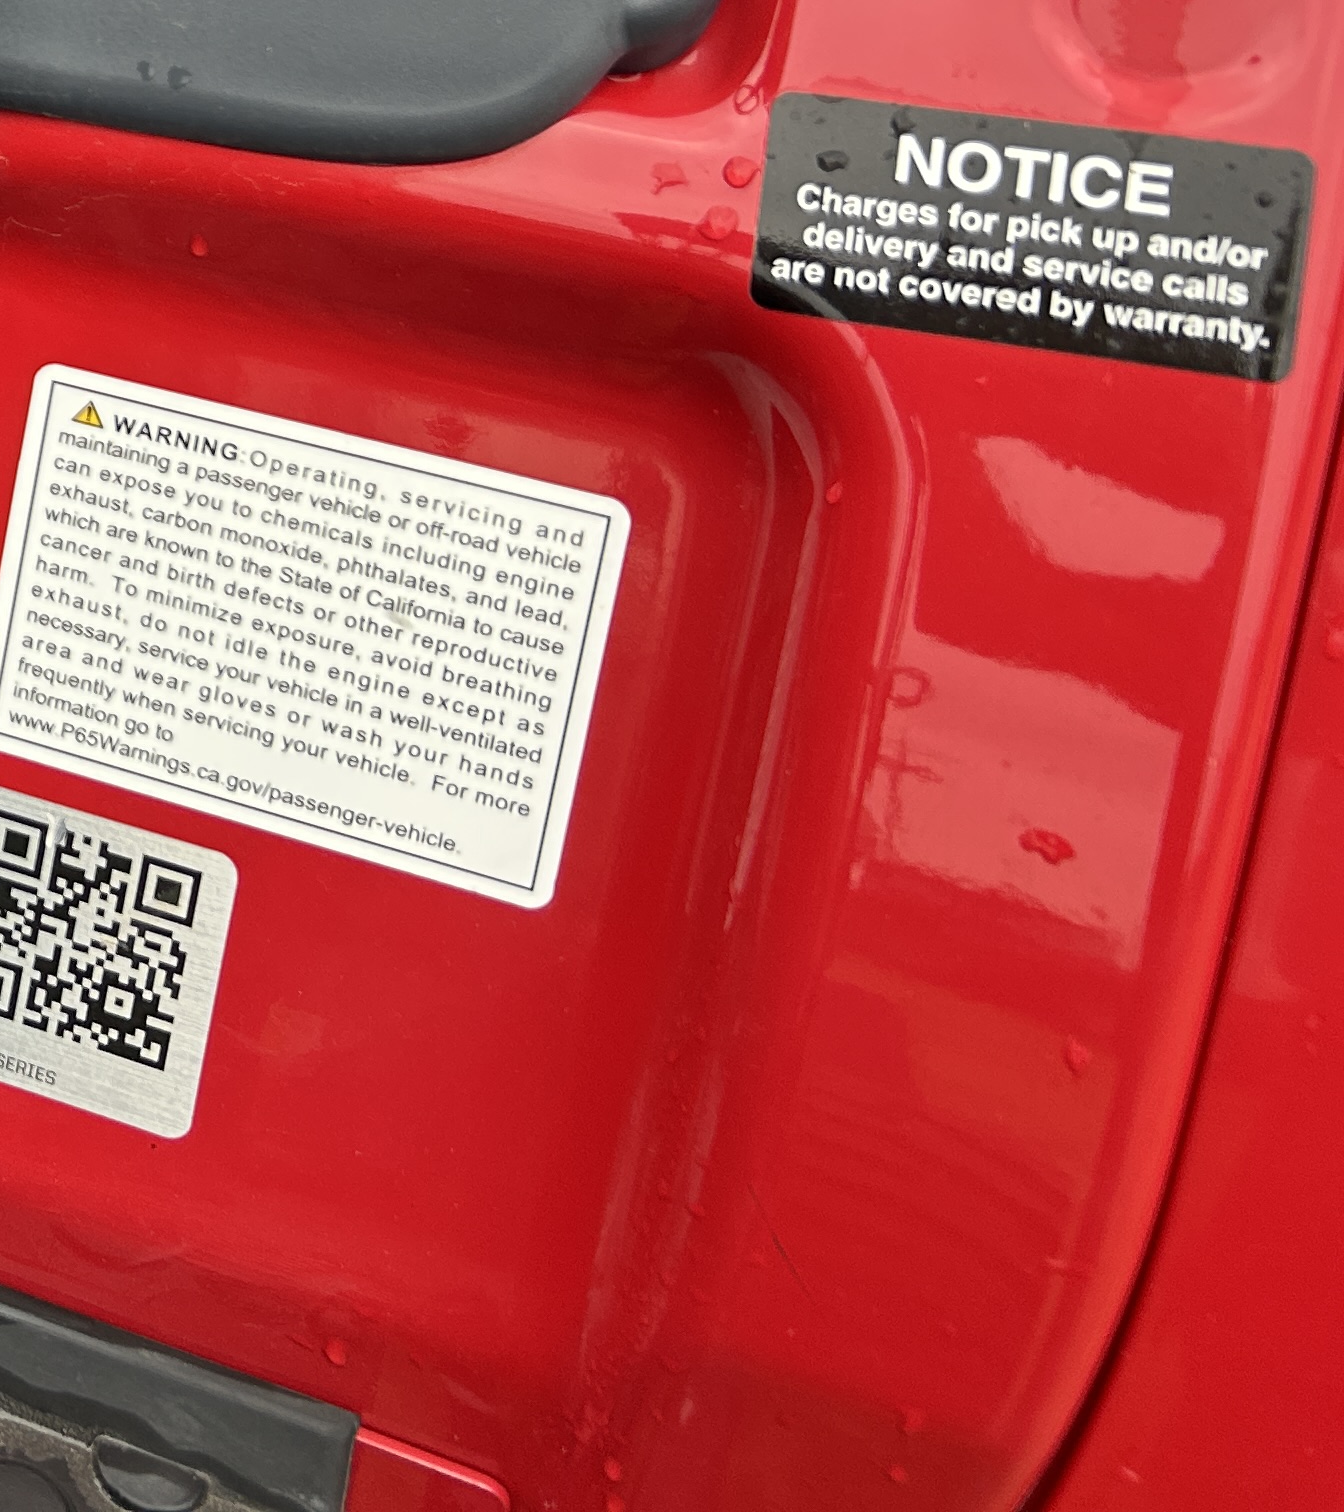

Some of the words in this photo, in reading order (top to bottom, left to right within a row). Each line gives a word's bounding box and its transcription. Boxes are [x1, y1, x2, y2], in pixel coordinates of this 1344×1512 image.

[796, 182, 939, 228] Charges
[947, 202, 1000, 235] for
[1006, 213, 1083, 247] pick
[1092, 227, 1140, 259] up
[1146, 233, 1269, 270] and/or
[894, 133, 1174, 218] NOTICE
[770, 258, 825, 285] are
[833, 266, 891, 295] not
[898, 274, 1042, 316] covered
[1049, 290, 1095, 328] by
[1103, 303, 1270, 353] warranty.
[802, 221, 940, 269] delivery
[946, 245, 1016, 275] and
[1022, 254, 1154, 293] service
[1162, 273, 1249, 307] calls
[49, 482, 135, 519] exhaust,
[141, 506, 214, 537] carbon
[219, 526, 329, 570] monoxide,
[335, 556, 457, 604] phthalates,
[464, 590, 508, 613] and
[514, 598, 568, 632] lead,
[53, 456, 92, 478] can
[99, 468, 177, 500] expose
[182, 489, 224, 512] you
[231, 499, 254, 520] to
[260, 508, 374, 550] chemicals
[381, 536, 487, 583] including
[495, 569, 575, 602] engine
[57, 431, 172, 475] maintaining
[176, 461, 190, 476] a
[194, 466, 304, 504] passenger
[309, 493, 383, 524] vehicle
[387, 514, 412, 531] or
[415, 520, 500, 554] off-road
[505, 543, 582, 574] vehicle
[400, 491, 522, 536] servicing
[536, 524, 585, 547] and
[35, 554, 94, 587] harm.
[111, 574, 139, 599] To
[145, 588, 244, 627] minimize
[251, 617, 361, 663] exposure,
[370, 650, 434, 678] avoid
[441, 664, 553, 714] breathing
[39, 533, 113, 564] cancer
[118, 554, 160, 578] and
[166, 562, 216, 593] birth
[223, 580, 305, 616] defects
[312, 606, 337, 624] or
[344, 615, 404, 641] other
[410, 632, 558, 683] reproductive
[44, 507, 101, 535] which
[105, 524, 139, 544] are
[143, 529, 210, 564] known
[215, 549, 236, 570] to
[240, 556, 274, 580] the
[278, 566, 334, 596] State
[338, 584, 362, 603] of
[366, 589, 466, 631] California
[472, 617, 494, 638] to
[499, 627, 565, 656] cause
[12, 681, 120, 729] information
[123, 718, 150, 737] go
[155, 723, 175, 743] to
[30, 584, 129, 626] exhaust,
[139, 612, 169, 633] do
[177, 624, 216, 647] not
[224, 633, 269, 662] idle
[279, 649, 317, 674] the
[327, 666, 411, 700] engine
[421, 691, 506, 727] except
[516, 717, 545, 736] as
